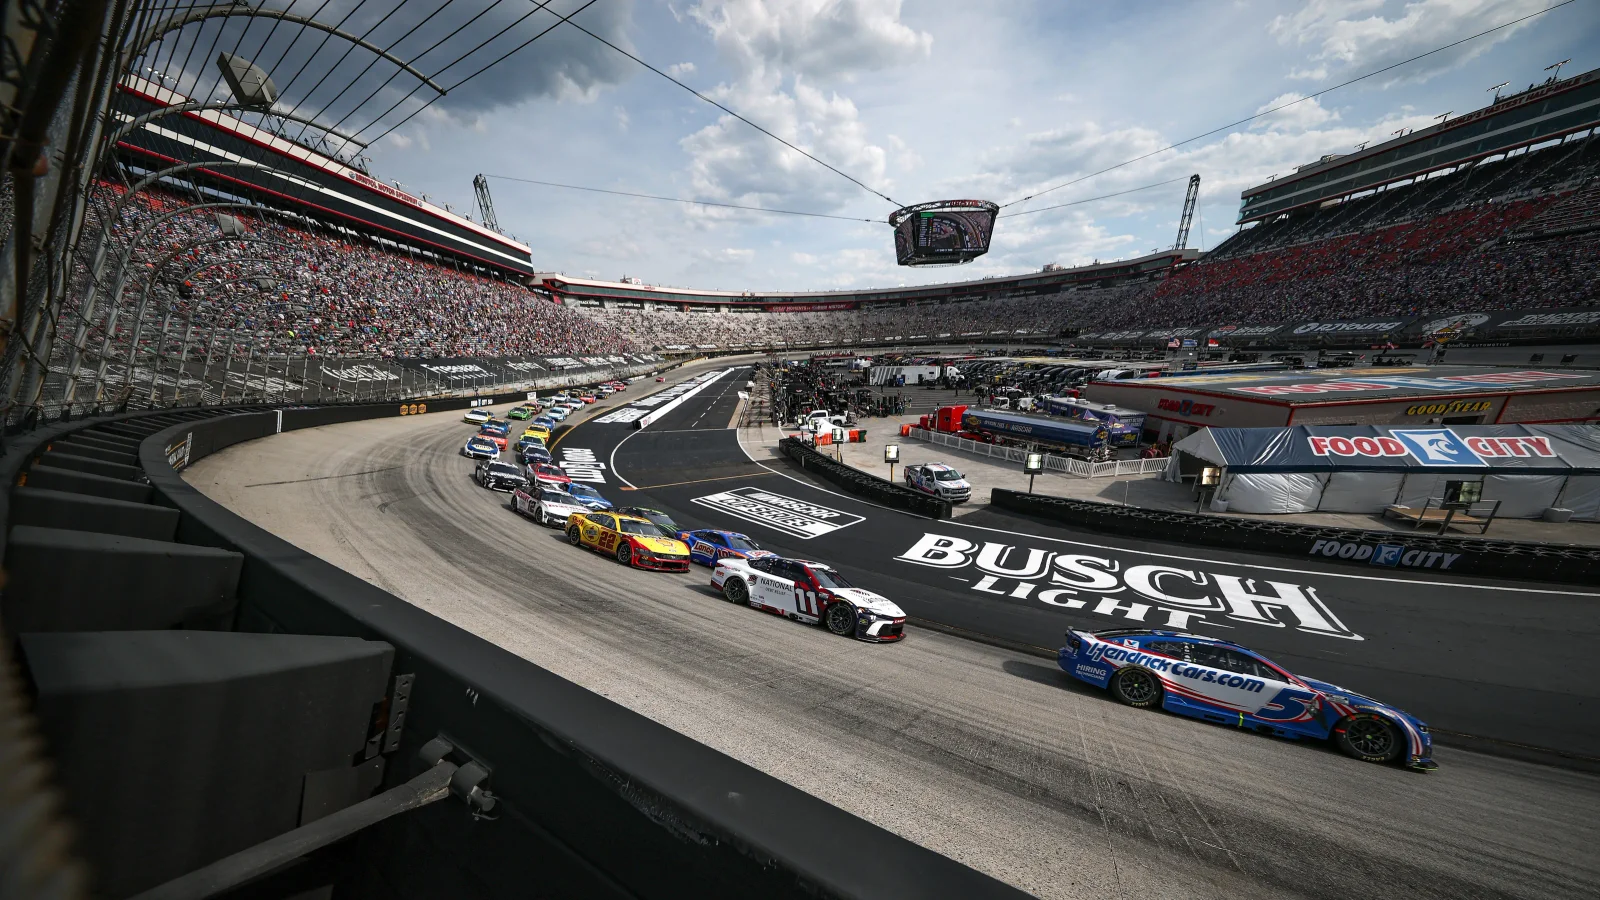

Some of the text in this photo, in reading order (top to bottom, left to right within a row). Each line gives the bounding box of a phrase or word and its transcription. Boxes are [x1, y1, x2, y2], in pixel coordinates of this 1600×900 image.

[1444, 78, 1582, 129] WORLD'S FASTEST HALF-MILE
[1191, 403, 1217, 417] CITY
[1308, 436, 1557, 459] FOOD CITY
[748, 503, 816, 528] SERIES
[763, 496, 841, 519] NASCAR
[572, 515, 584, 527] Shell
[599, 530, 617, 550] 22
[693, 543, 715, 555] Lance
[1309, 539, 1462, 570] FOOD CITY
[760, 577, 794, 593] NATIONAL
[894, 532, 1365, 641] BUSCH
[795, 587, 819, 615] 11
[970, 575, 1206, 629] LIGHT
[1076, 663, 1107, 677] HIRING
[1255, 688, 1322, 722] 5
